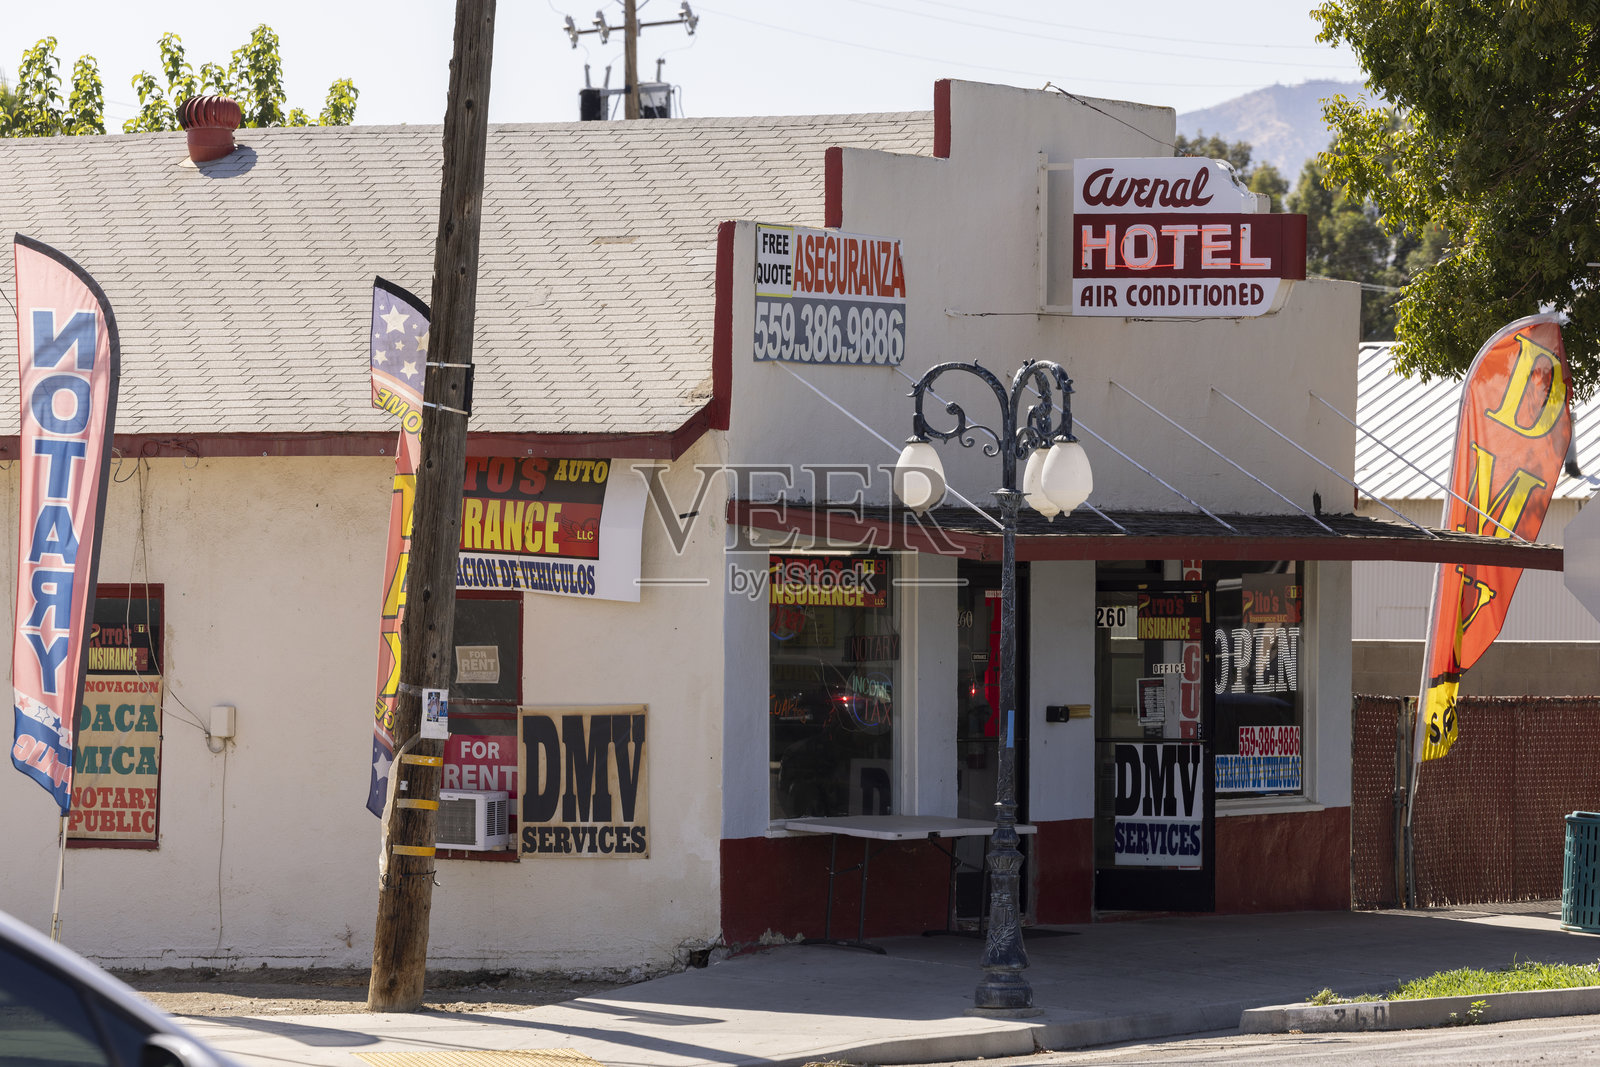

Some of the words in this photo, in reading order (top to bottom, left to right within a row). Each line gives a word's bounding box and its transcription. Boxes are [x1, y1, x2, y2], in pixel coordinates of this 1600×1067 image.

[762, 233, 789, 255] FREE
[1081, 223, 1271, 270] HOTEL
[757, 263, 792, 285] QUOTE
[793, 234, 906, 298] ASEGURANZA
[1080, 286, 1117, 307] AIR
[1126, 283, 1264, 307] CONDITIONED
[754, 301, 904, 364] 559.386.9886
[553, 460, 608, 484] AUTO
[459, 498, 562, 554] RANCE
[577, 530, 593, 541] LLC
[455, 557, 498, 588] ACION
[498, 560, 521, 589] DE
[520, 561, 597, 596] VEHICULOS
[1096, 607, 1125, 627] 260
[1138, 617, 1190, 639] INSURANCE
[88, 648, 137, 670] INSURANCE
[461, 659, 496, 671] RENT
[1153, 664, 1185, 673] OFFICE
[460, 742, 500, 760] FOR
[1240, 727, 1300, 756] 559-386-9886
[443, 765, 518, 791] RENT
[523, 715, 646, 822] DMV
[1115, 744, 1201, 817] DMV
[70, 787, 158, 809] NOTARY
[68, 811, 155, 833] PUBLIC
[522, 826, 646, 854] SERVICES
[1115, 820, 1201, 856] SERVICES
